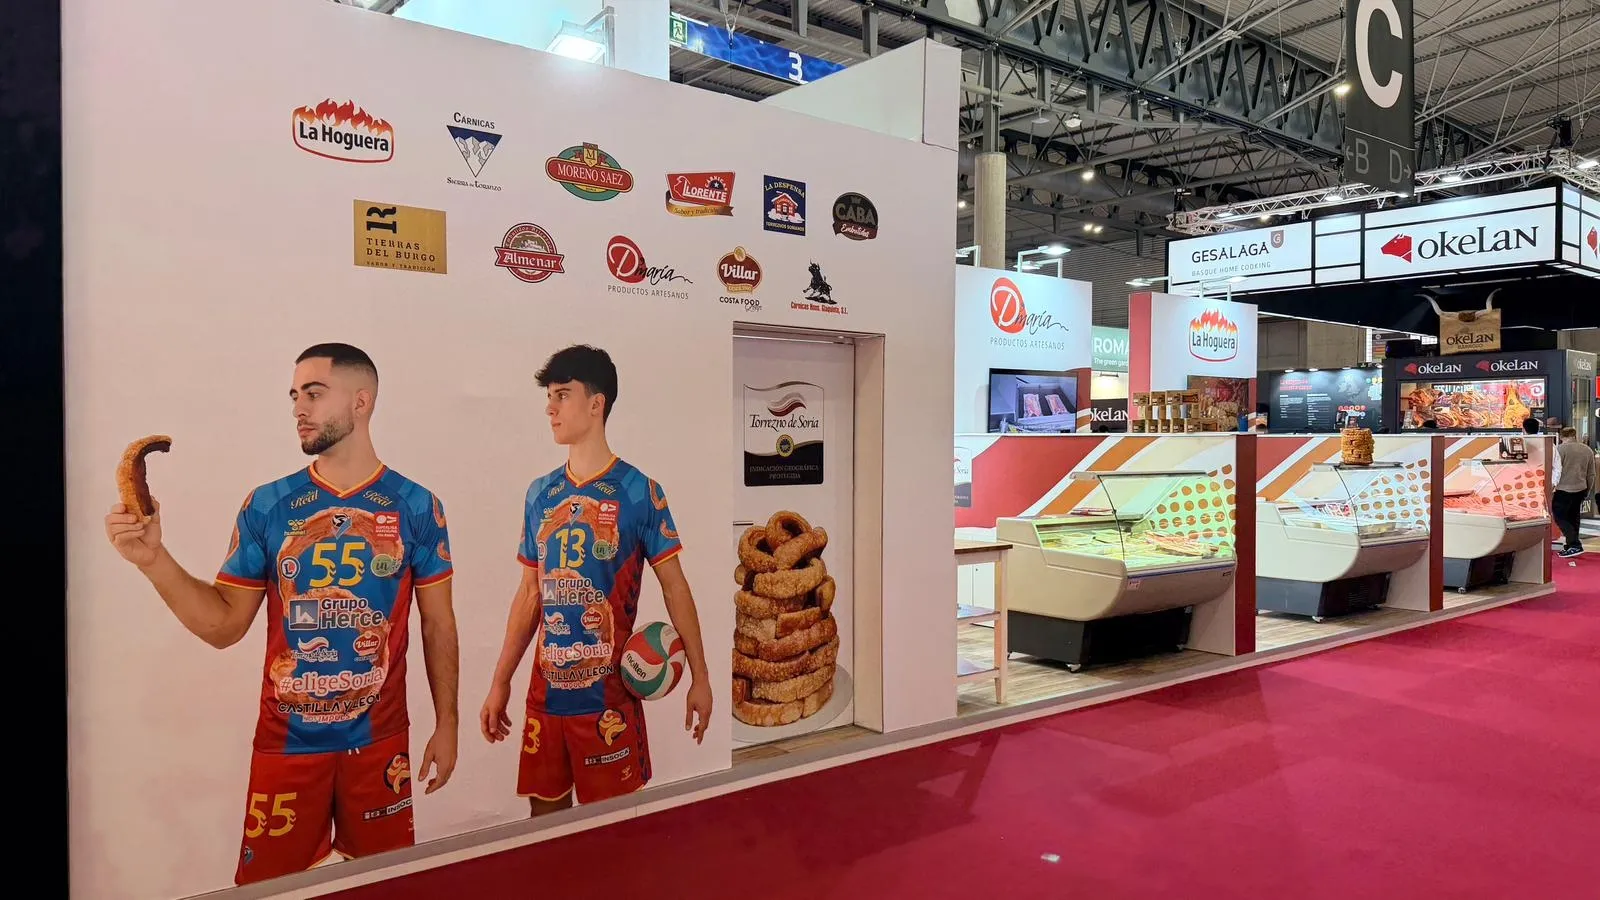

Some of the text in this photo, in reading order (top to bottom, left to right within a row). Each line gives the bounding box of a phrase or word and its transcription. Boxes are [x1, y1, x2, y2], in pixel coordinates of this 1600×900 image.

[1355, 0, 1404, 109] C
[788, 52, 803, 82] 3
[299, 121, 389, 151] La Hoguera
[1355, 137, 1370, 175] B
[557, 163, 623, 186] MORENO SAEZ
[1389, 149, 1403, 184] D
[764, 182, 805, 198] LA DESPENSA
[836, 203, 876, 226] CABA
[366, 237, 420, 250] TIERRAS
[366, 247, 435, 262] DEL BURGO
[503, 251, 557, 269] Almenar
[720, 263, 758, 281] Villar
[1191, 261, 1271, 276] BASQUE HOME COOKING
[607, 284, 689, 300] PRODUCTOS ARTESANOS
[719, 296, 760, 306] COSTA FOOD
[990, 336, 1065, 351] PRODUCTOS ARTESANOS
[1192, 331, 1235, 352] La Hoguera
[749, 413, 819, 432] Torrezno de Soria
[555, 528, 586, 569] 13
[309, 541, 366, 588] 55
[558, 578, 591, 589] Grupo
[321, 598, 367, 611] Grupo
[557, 589, 604, 605] Herce
[321, 610, 383, 629] Herce
[625, 652, 648, 680] molten
[280, 665, 384, 696] #eligeSoria
[278, 702, 341, 714] CASTILLA
[245, 791, 297, 839] 55
